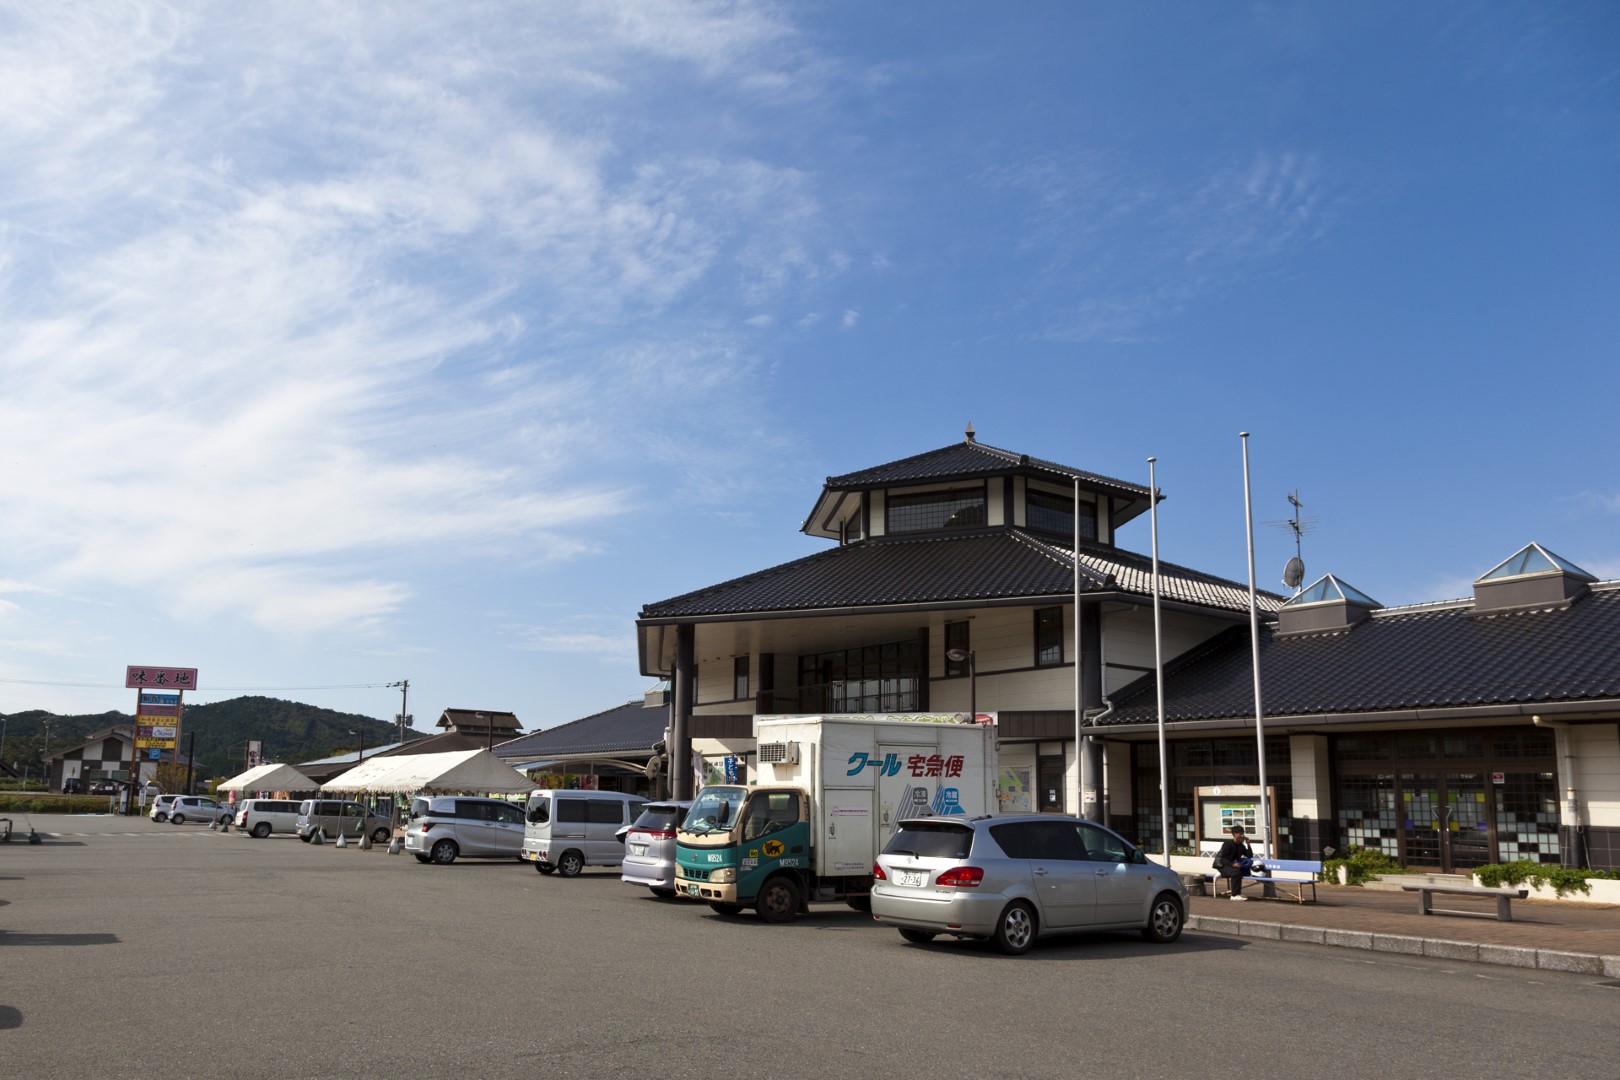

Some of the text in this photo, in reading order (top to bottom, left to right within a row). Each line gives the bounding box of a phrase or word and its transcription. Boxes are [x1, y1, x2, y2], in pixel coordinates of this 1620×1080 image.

[132, 669, 191, 685] 味番地
[907, 754, 965, 778] 宅急便
[779, 858, 799, 867] M9524
